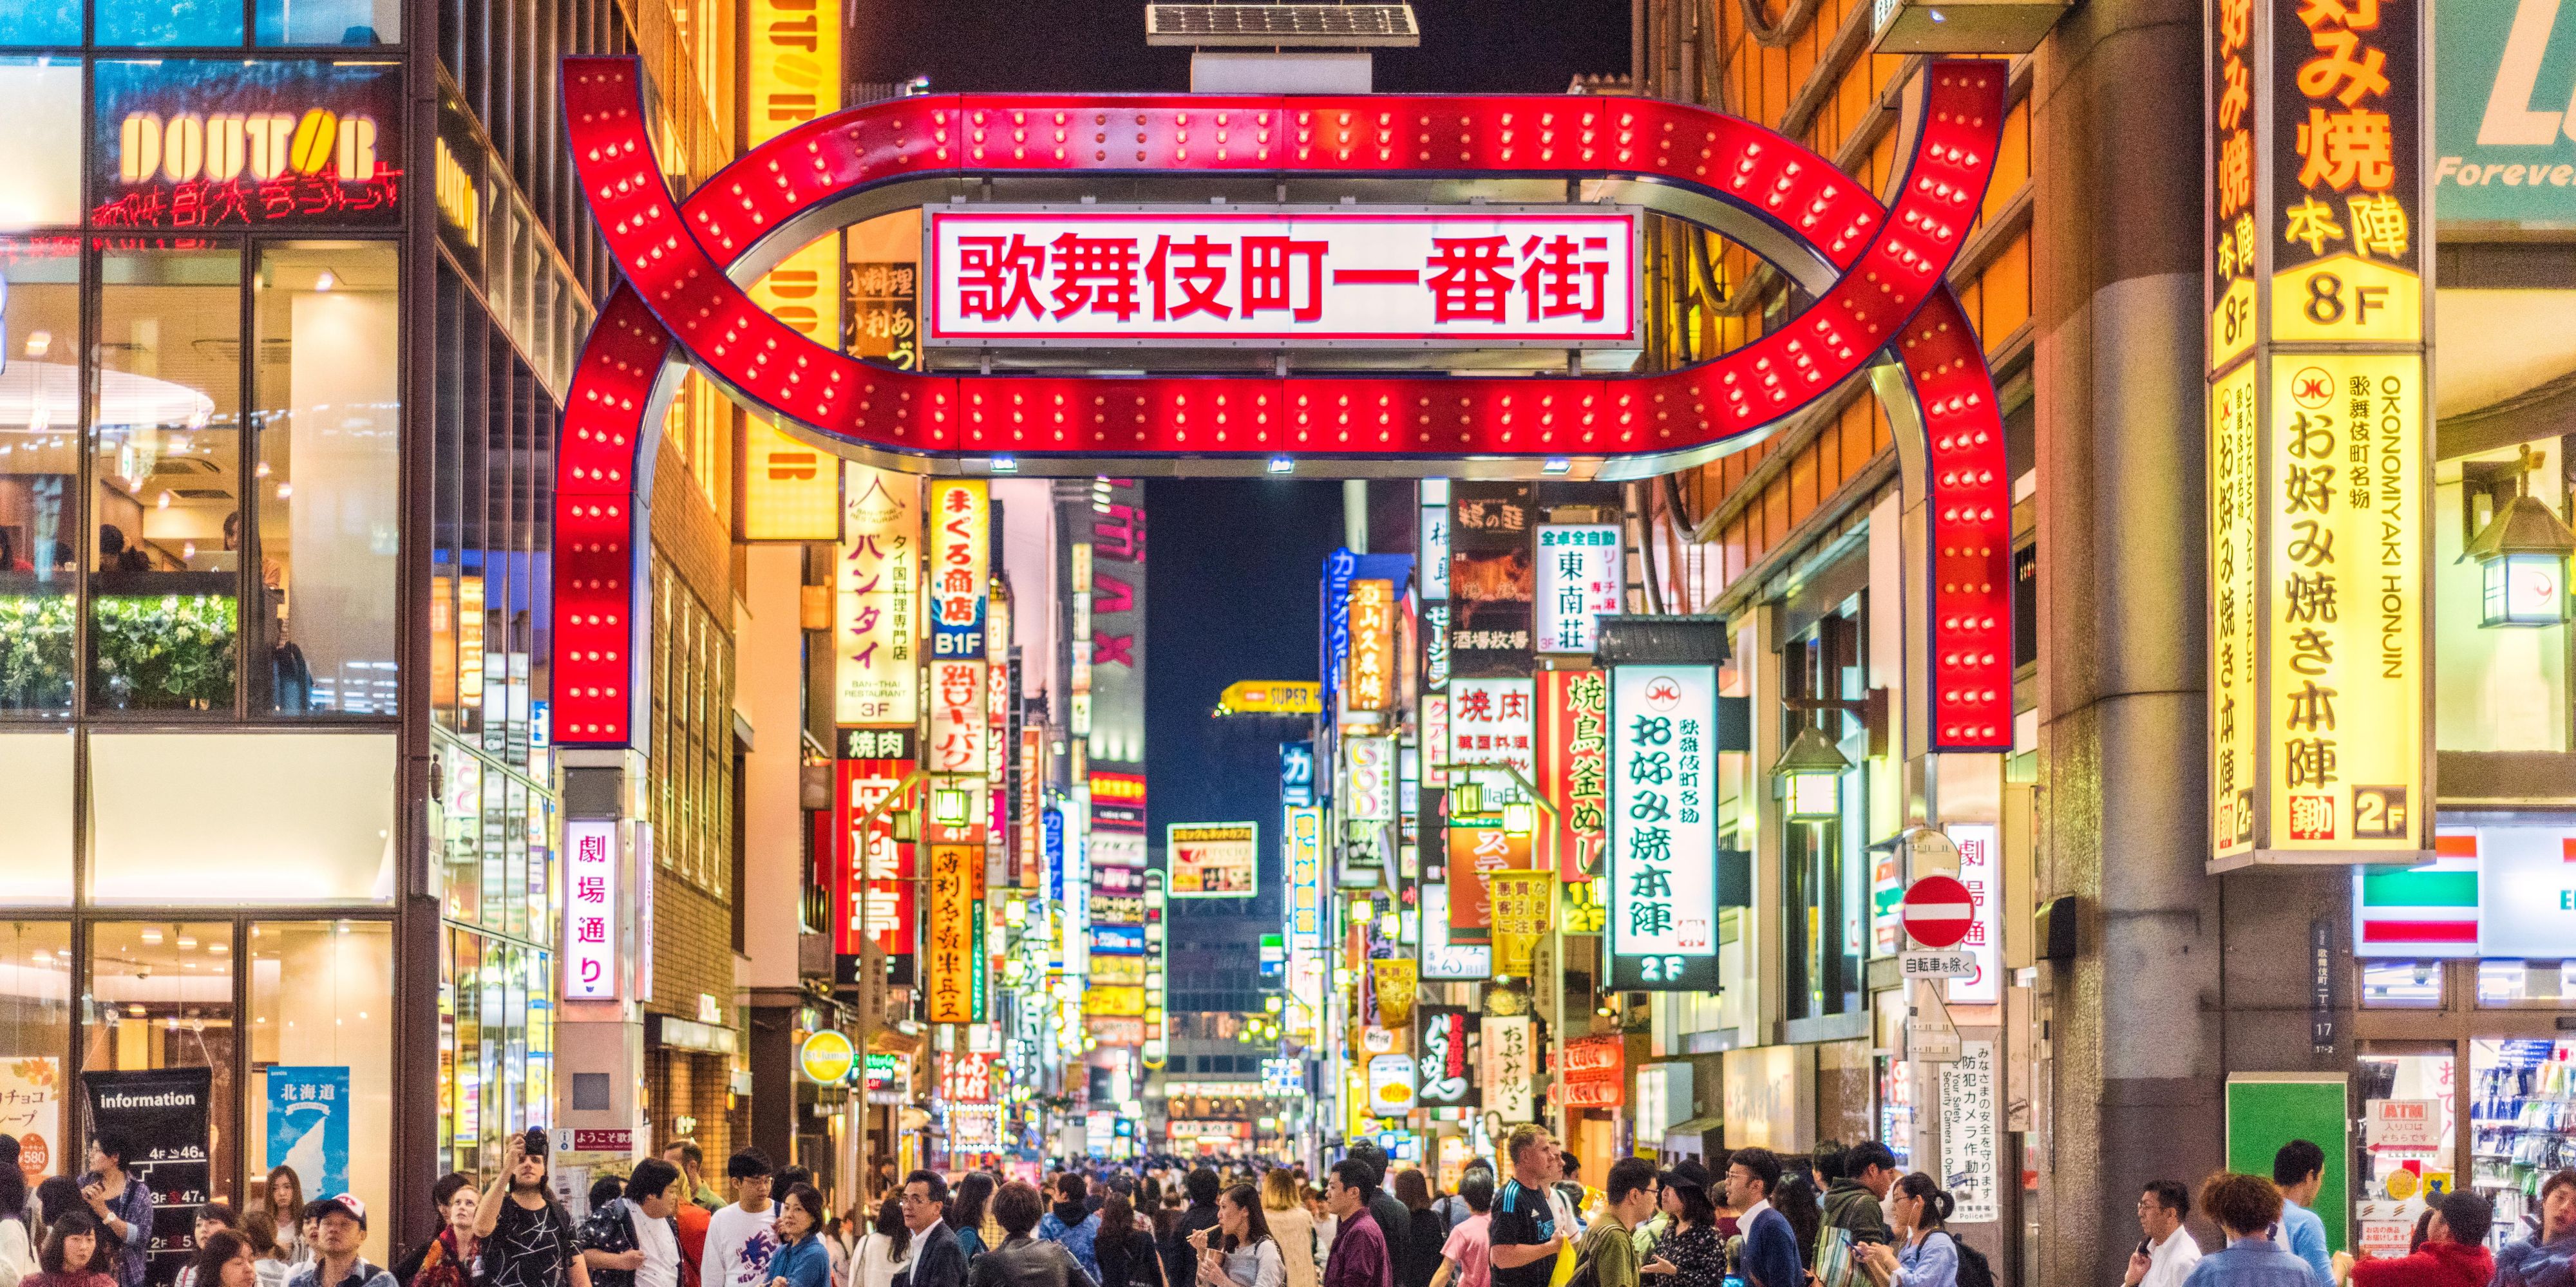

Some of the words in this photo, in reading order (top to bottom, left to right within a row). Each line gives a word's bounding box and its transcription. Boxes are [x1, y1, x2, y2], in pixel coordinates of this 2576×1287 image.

[768, 0, 823, 121] TOR
[120, 108, 377, 183] DOUTOR
[2286, 195, 2407, 256] 本陣
[2219, 212, 2253, 281] 本陣
[957, 232, 1609, 324] 歌舞伎町一番街
[2304, 272, 2389, 324] 8F
[2224, 295, 2249, 347] 8F
[2349, 376, 2370, 510] 歌舞伎町名物
[2381, 376, 2401, 567] OKONOMIYAKI
[849, 512, 903, 524] RESTAURANT
[1542, 531, 1615, 546] 全卓全自動
[944, 490, 974, 622] まぐろ商店
[848, 534, 885, 669] バンタイ
[893, 534, 907, 661] タイ国料理専門店
[1558, 552, 1584, 649] 東南荘
[2285, 411, 2338, 790] お好み焼き本陣
[2219, 434, 2235, 800] お好み焼き本陣
[2381, 576, 2401, 679] HONJIN
[936, 634, 981, 654] B1F
[1454, 631, 1528, 649] 酒場牧場
[1540, 639, 1554, 649] 3F
[862, 704, 889, 717] 3F
[1271, 688, 1307, 706] SUPER
[849, 731, 904, 758] 焼肉
[1567, 674, 1605, 874] 焼鳥釜めし
[1680, 719, 1699, 823] 歌舞伎町名物
[1629, 715, 1673, 936] お好み焼本陣
[2238, 798, 2251, 835] 2F
[2291, 796, 2333, 830] 鋤
[2356, 792, 2406, 832] 2F
[943, 825, 972, 841] 4F
[1497, 881, 1546, 896] 悪質な
[2561, 890, 2576, 910] E
[578, 836, 605, 982] 劇場通り
[1497, 901, 1546, 915] 客引き
[1567, 908, 1605, 931] 2F
[1497, 920, 1546, 934] に注意
[1641, 956, 1685, 981] 2F
[1906, 957, 1970, 973] 自転車を除く
[2316, 1024, 2332, 1035] 17
[1499, 1026, 1527, 1111] お好み焼き
[101, 1093, 194, 1108] information
[281, 1084, 335, 1101] 北海道
[1943, 1072, 1952, 1106] Security
[1953, 1096, 1961, 1123] Safety
[1962, 1056, 1978, 1192] 防犯カメラ作動中
[1978, 1047, 1991, 1199] みなさまの安全を守ります
[2384, 1104, 2423, 1118] ATM
[149, 1148, 165, 1159] 4F
[151, 1192, 167, 1203] 3F
[151, 1237, 167, 1248] 2F
